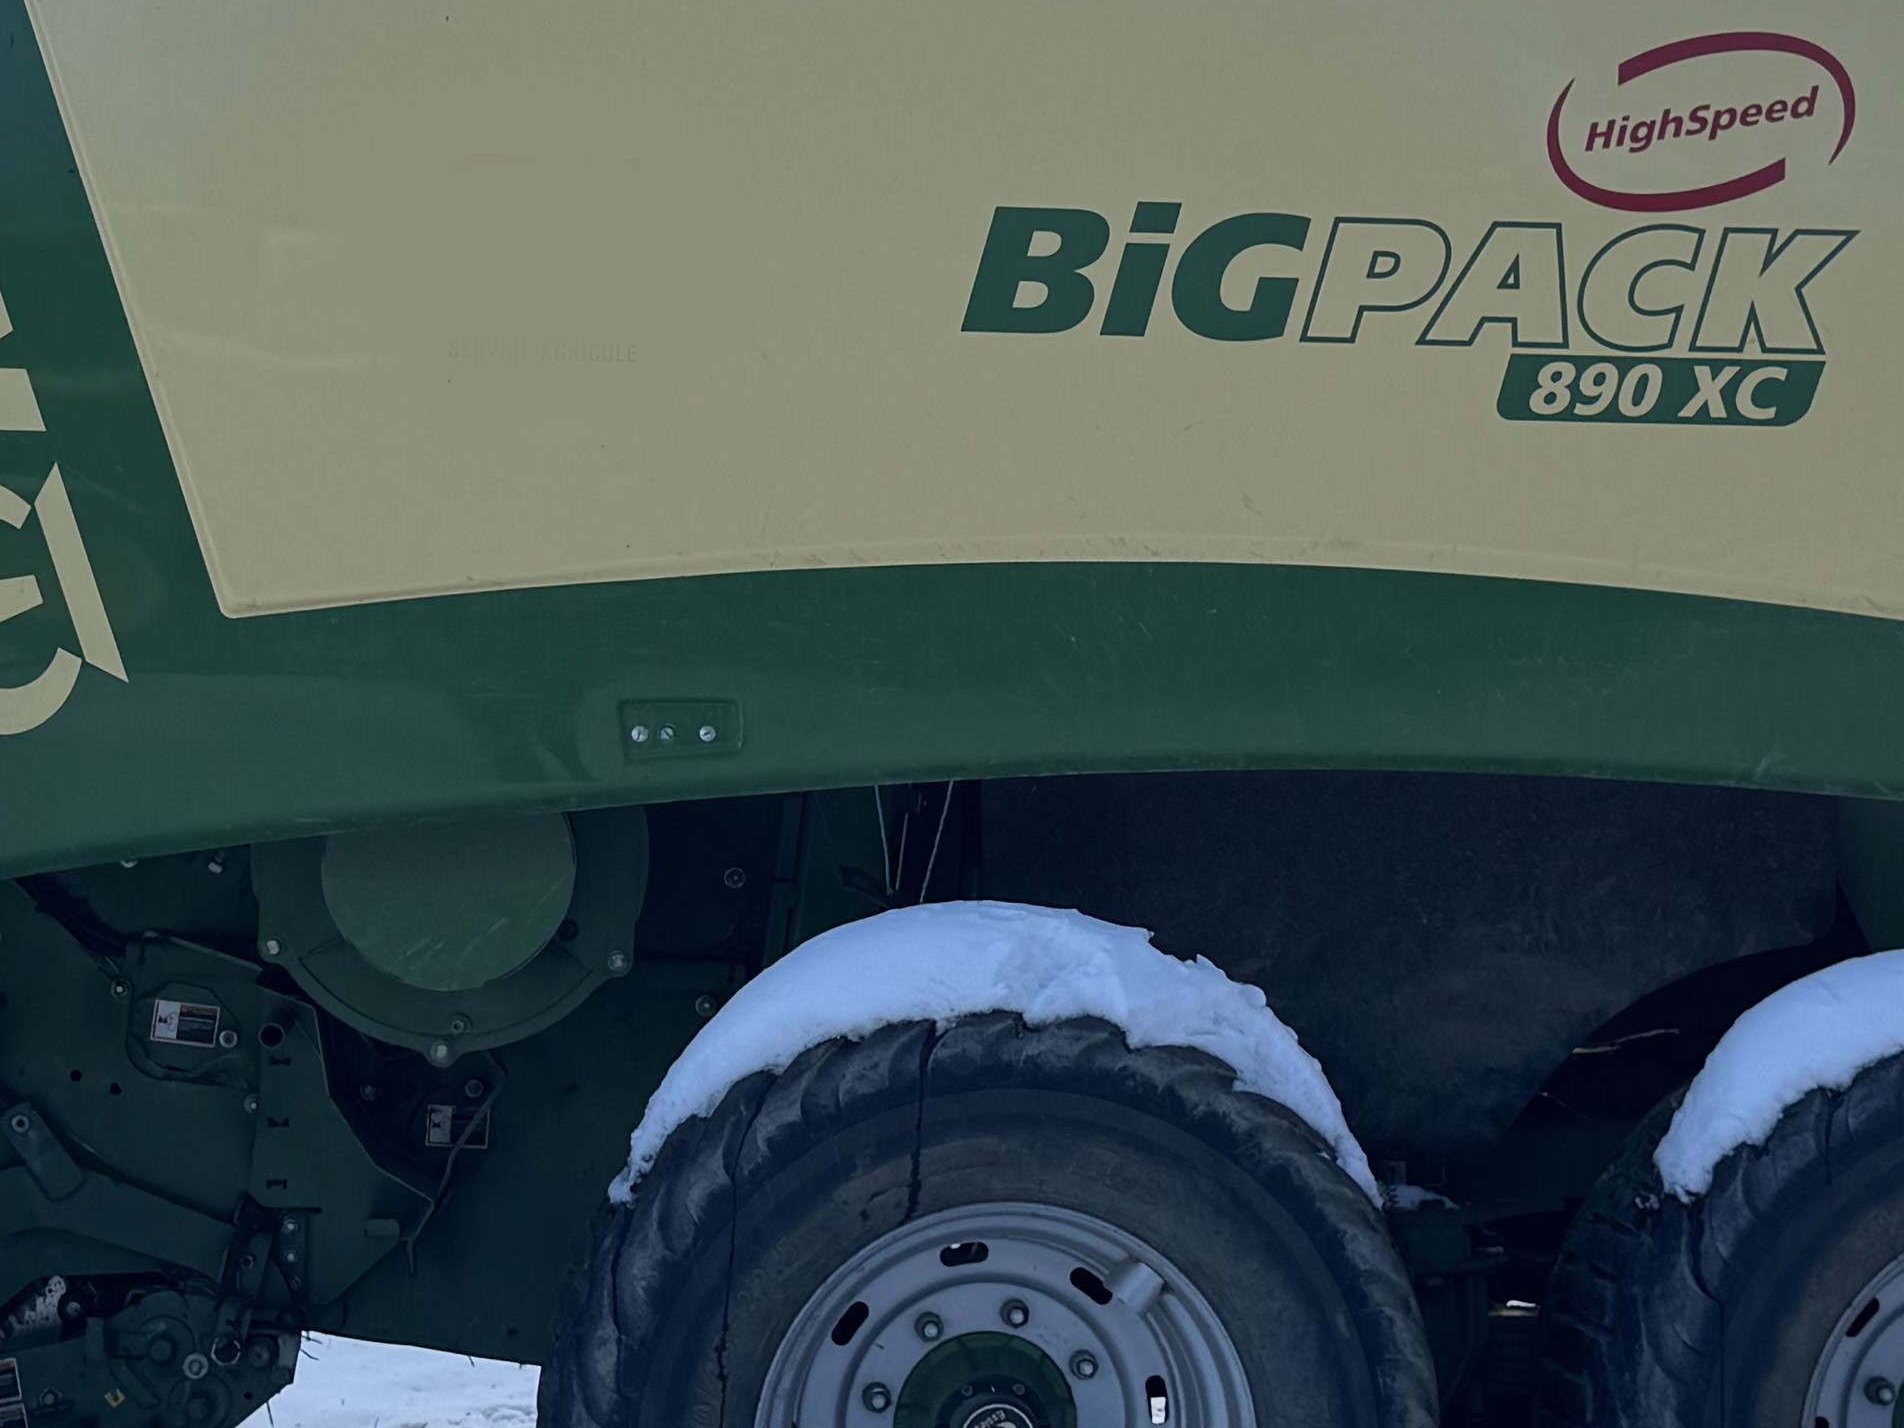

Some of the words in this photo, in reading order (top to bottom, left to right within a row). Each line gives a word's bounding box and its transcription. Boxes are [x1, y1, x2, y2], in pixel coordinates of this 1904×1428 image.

[1584, 86, 1821, 153] HighSpeed
[1528, 362, 1663, 419] 890
[1679, 364, 1788, 421] XC
